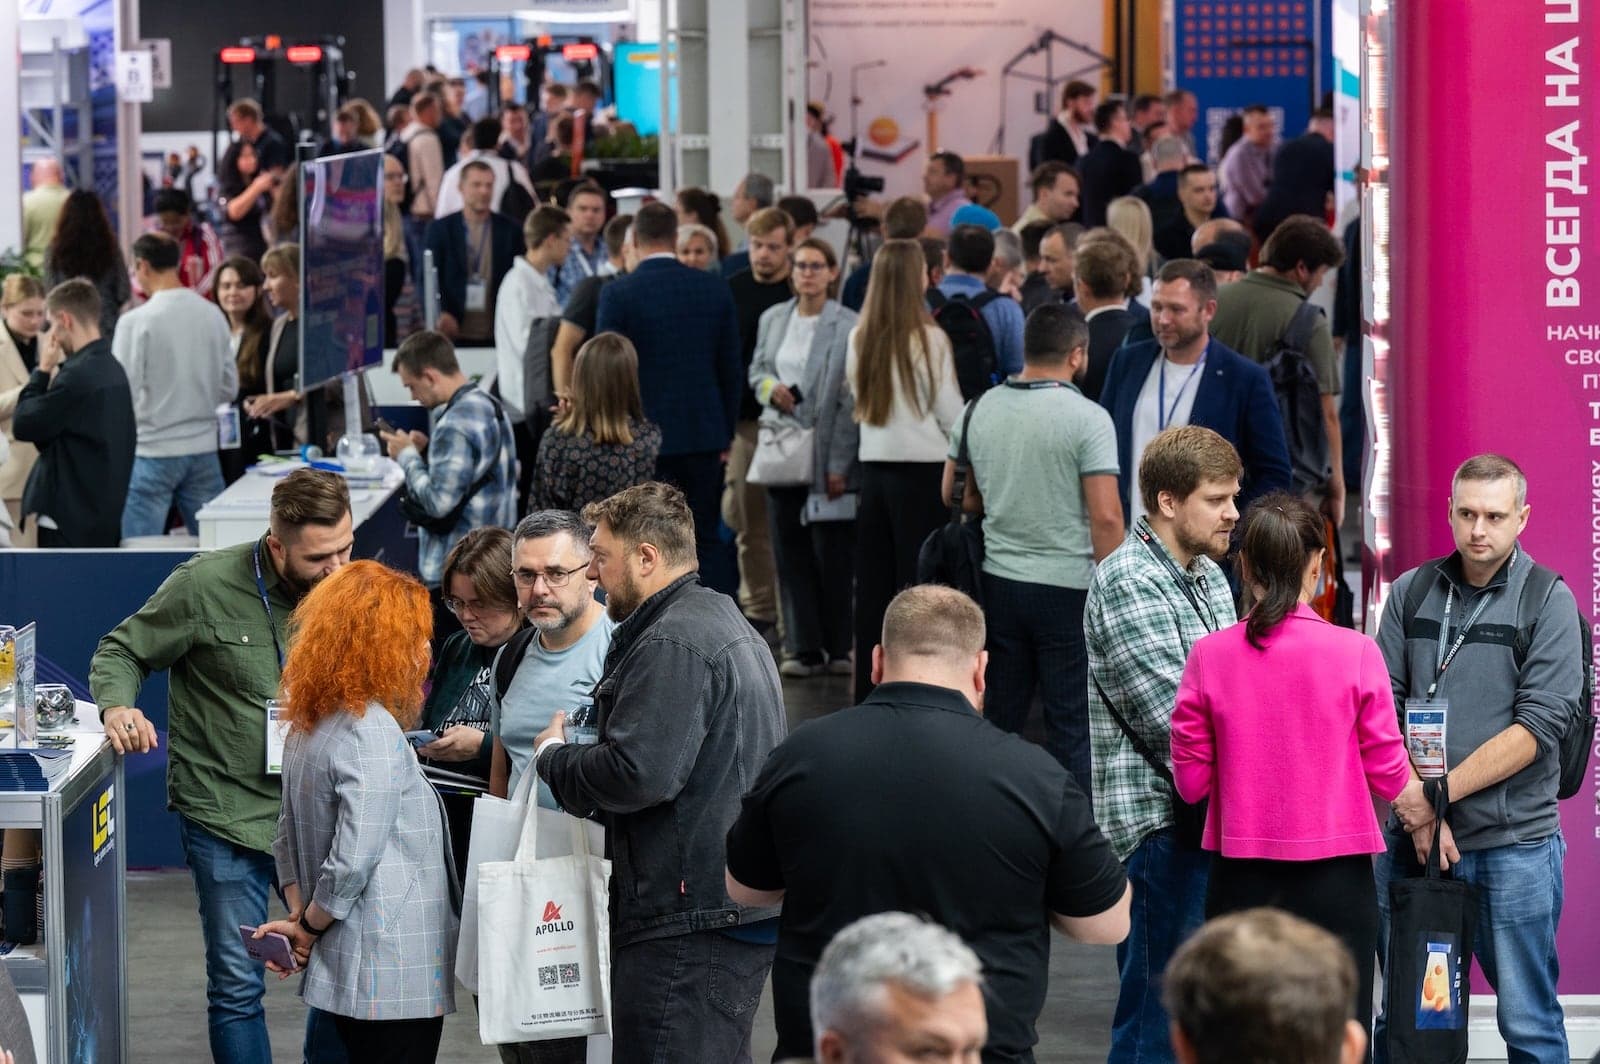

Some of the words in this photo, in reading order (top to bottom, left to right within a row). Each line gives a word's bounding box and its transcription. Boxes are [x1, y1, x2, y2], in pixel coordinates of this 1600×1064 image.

[1545, 36, 1580, 107] НА
[1545, 120, 1588, 307] ВСЕГДА
[535, 920, 575, 936] APOLLO
